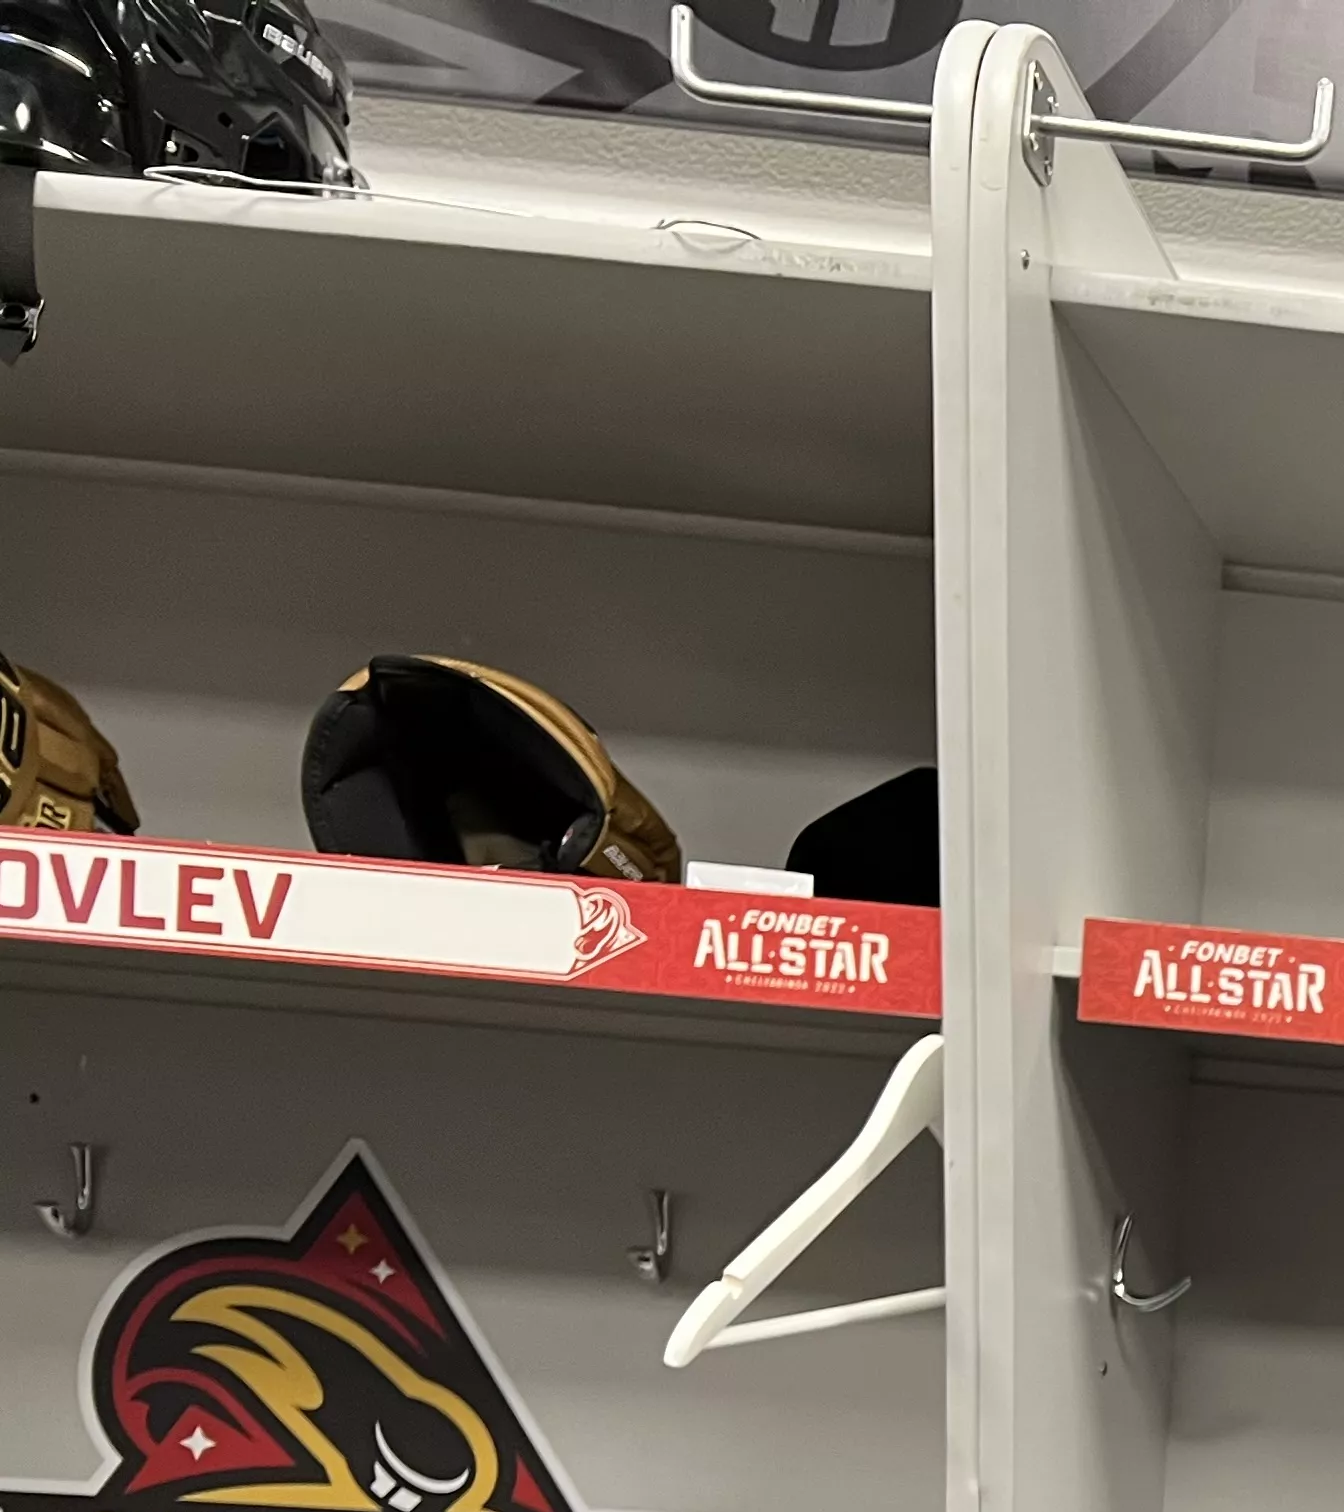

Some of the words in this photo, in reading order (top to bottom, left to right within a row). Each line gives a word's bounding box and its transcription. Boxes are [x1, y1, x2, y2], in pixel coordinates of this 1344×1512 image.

[0, 850, 292, 939] OVLEV
[741, 909, 846, 937] FONBET
[694, 919, 773, 973] ALL
[779, 932, 889, 983] STAR
[1134, 949, 1211, 1003] ALL
[1218, 968, 1325, 1013] STAR
[1180, 940, 1283, 968] FONBET
